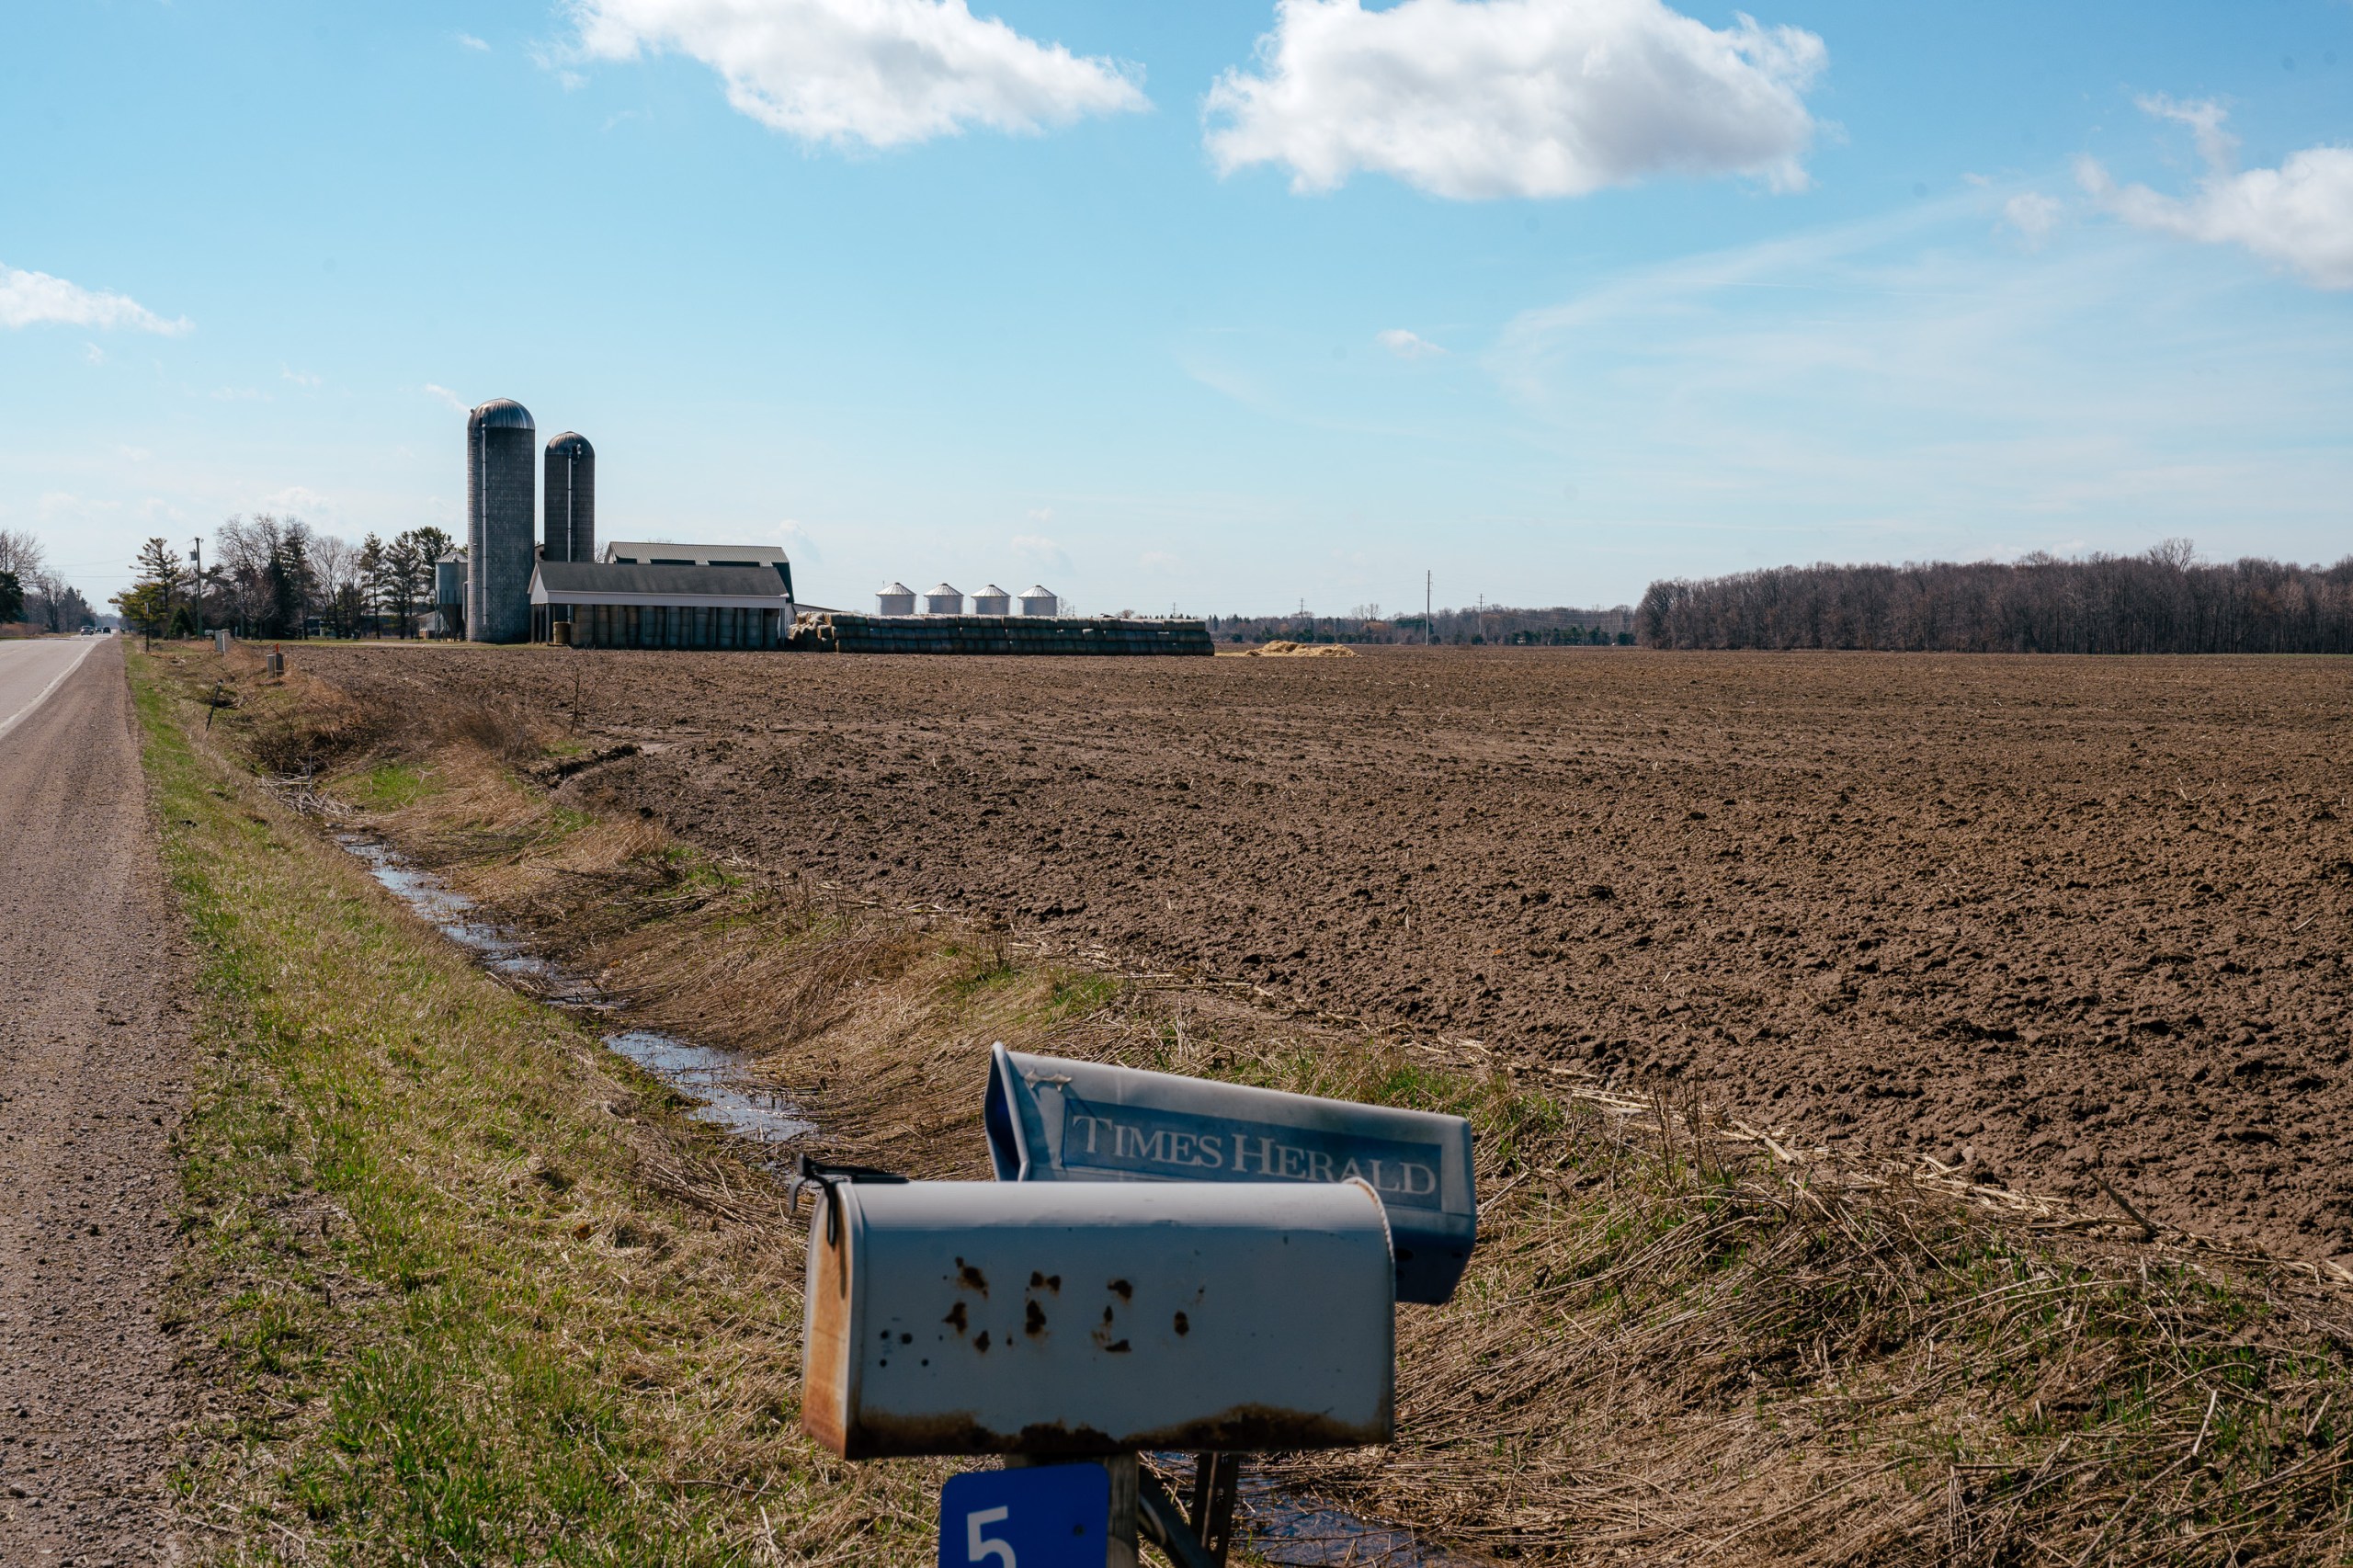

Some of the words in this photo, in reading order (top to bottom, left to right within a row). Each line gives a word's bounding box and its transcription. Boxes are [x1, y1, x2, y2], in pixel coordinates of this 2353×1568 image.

[1073, 1115, 1222, 1168] TIMES
[1232, 1133, 1436, 1195] HERALD
[967, 1506, 1017, 1568] 5
